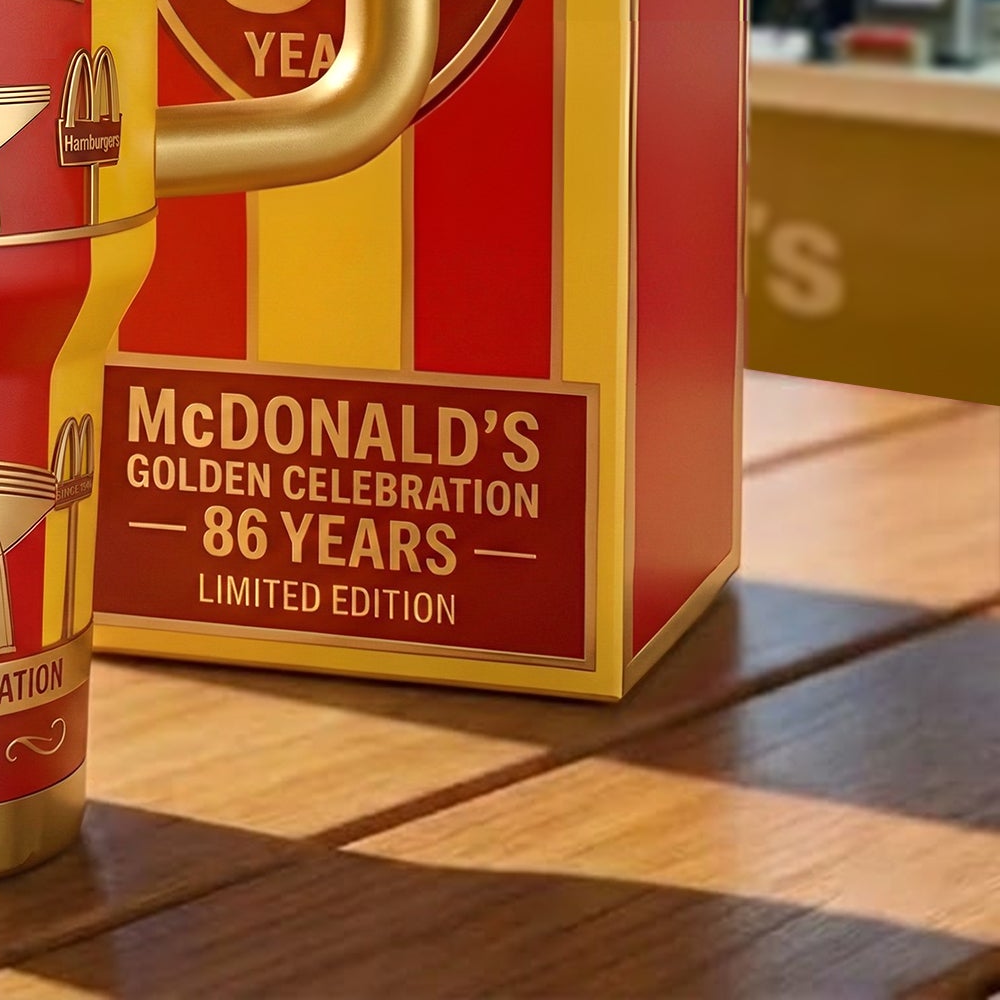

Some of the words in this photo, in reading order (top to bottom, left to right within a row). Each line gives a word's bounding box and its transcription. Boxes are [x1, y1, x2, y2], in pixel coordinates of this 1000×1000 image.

[244, 31, 338, 79] YEA
[64, 134, 120, 153] Hamburgers
[127, 386, 540, 473] McDONALD'S
[126, 453, 271, 498] GOLDEN
[282, 465, 539, 519] CELEBRATION
[202, 505, 268, 560] 86
[279, 510, 457, 577] YEARS
[199, 573, 321, 613] LIMITED
[332, 584, 456, 626] EDITION
